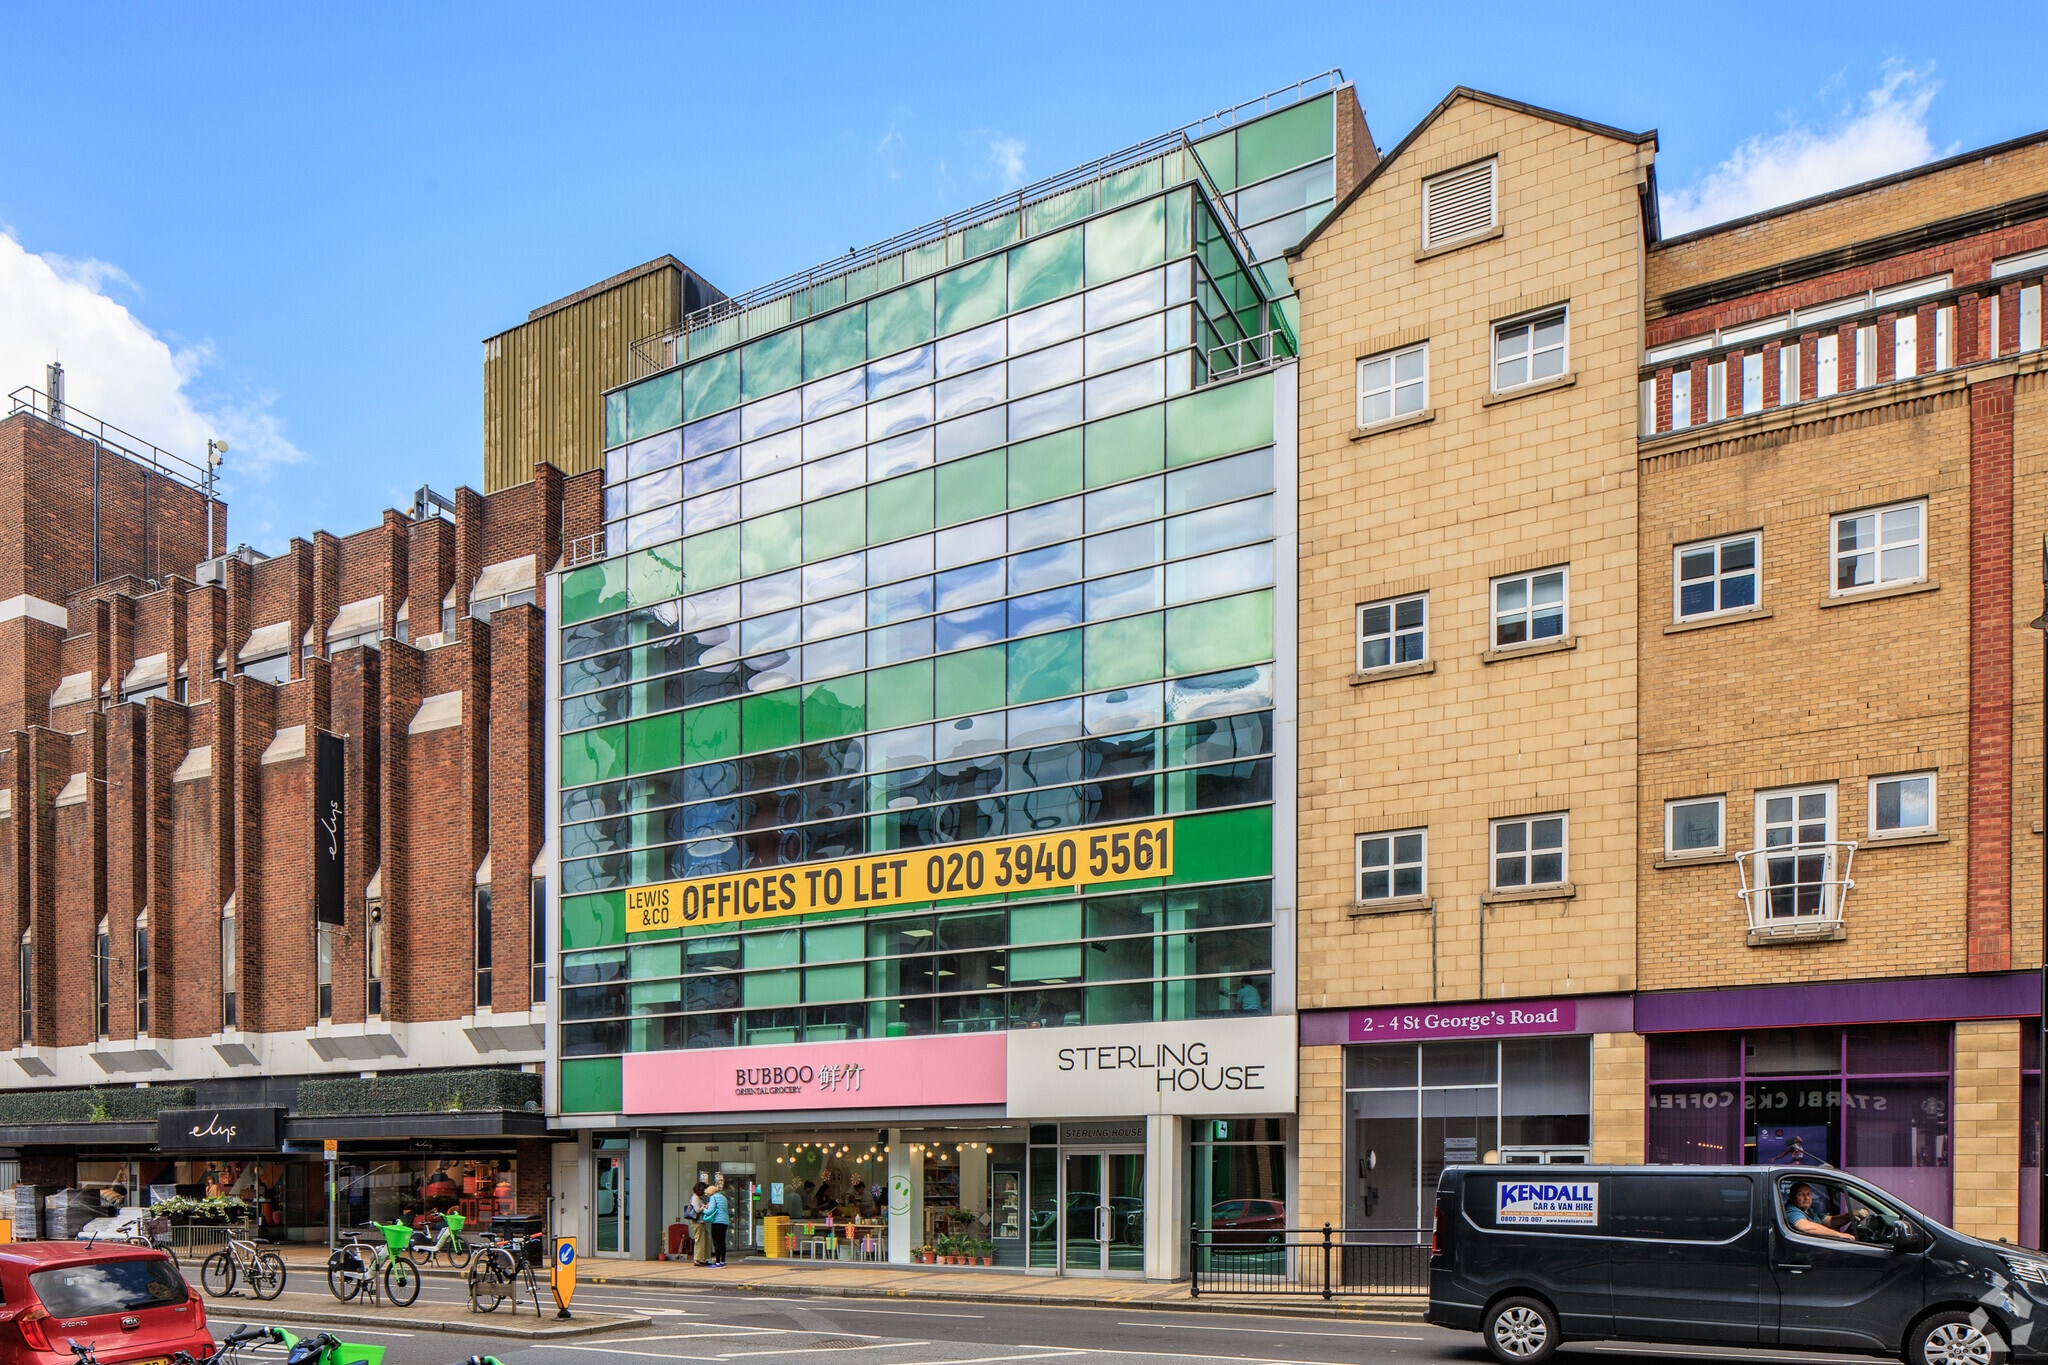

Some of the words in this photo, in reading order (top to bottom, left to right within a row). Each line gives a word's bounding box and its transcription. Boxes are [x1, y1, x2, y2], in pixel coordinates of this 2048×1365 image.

[321, 800, 342, 860] elys
[682, 873, 796, 920] OFFICES
[805, 867, 842, 906] TO
[854, 860, 907, 902] LET
[927, 850, 984, 894] 020
[995, 839, 1076, 887] 3940
[1089, 828, 1168, 877] 5561
[629, 889, 669, 909] LEWIS
[642, 908, 669, 926] &CO
[1363, 1017, 1373, 1032] 2
[1389, 1016, 1398, 1031] 4
[1403, 1015, 1420, 1030] St
[1424, 1011, 1505, 1031] George's
[1509, 1008, 1559, 1025] Road
[1058, 1042, 1208, 1071] STERLING
[735, 1065, 814, 1087] BUBBOO
[818, 1063, 865, 1092] 鲜竹
[1156, 1065, 1265, 1092] HOUSE
[735, 1087, 769, 1096] ORIENTAL
[769, 1085, 802, 1095] GROCERY
[189, 1113, 237, 1143] elys
[1065, 1128, 1109, 1138] STERLING
[1112, 1127, 1142, 1137] HOUSE
[1501, 1184, 1593, 1210] KENDALL
[1533, 1202, 1548, 1211] CAR
[1550, 1202, 1556, 1211] &
[1557, 1202, 1573, 1211] VAN
[1575, 1203, 1593, 1211] HIRE
[60, 1320, 88, 1329] picanto
